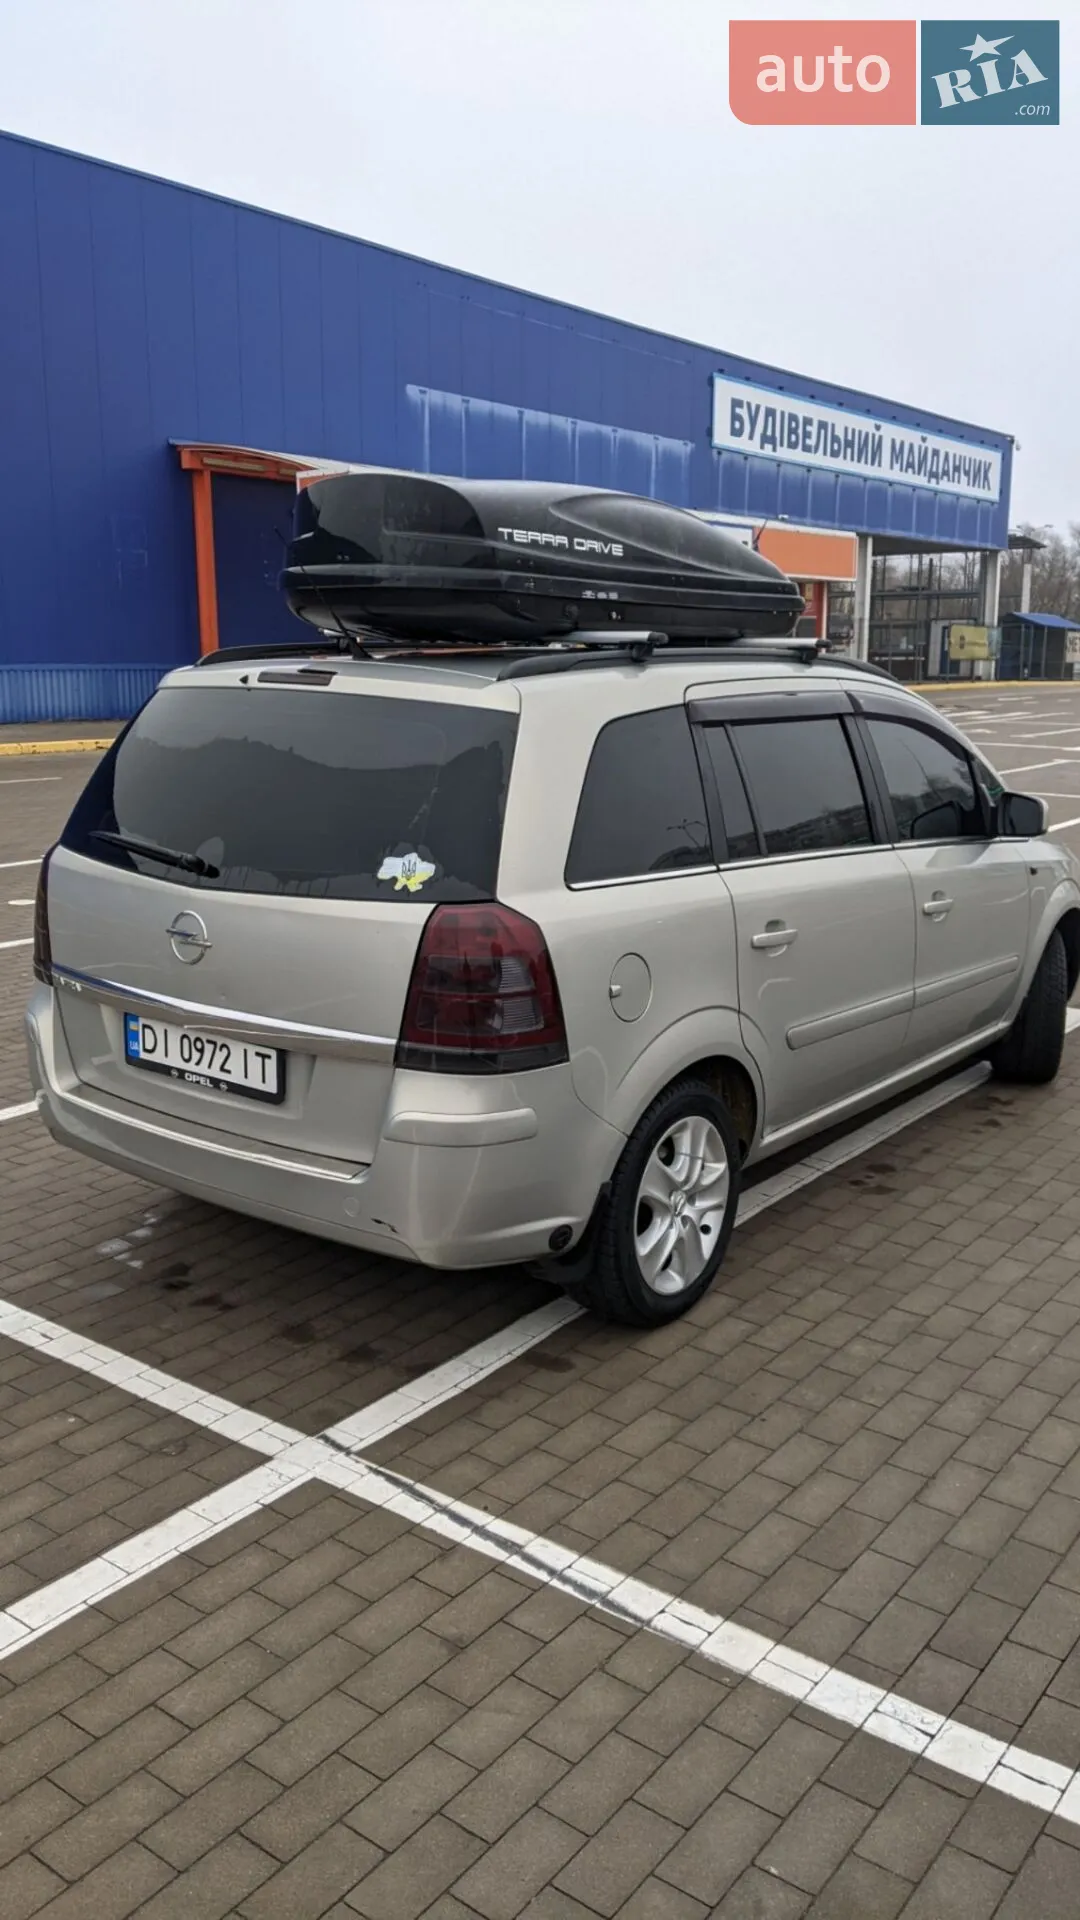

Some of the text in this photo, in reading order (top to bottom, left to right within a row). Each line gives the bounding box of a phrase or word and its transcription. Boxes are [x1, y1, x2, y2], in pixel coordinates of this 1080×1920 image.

[729, 397, 993, 491] БУДІВЕЛЬНИЙ МАЙДАНЧИК
[498, 527, 624, 556] TERRA DRIVE
[179, 1033, 232, 1075] 0972
[184, 1073, 213, 1088] OPEL
